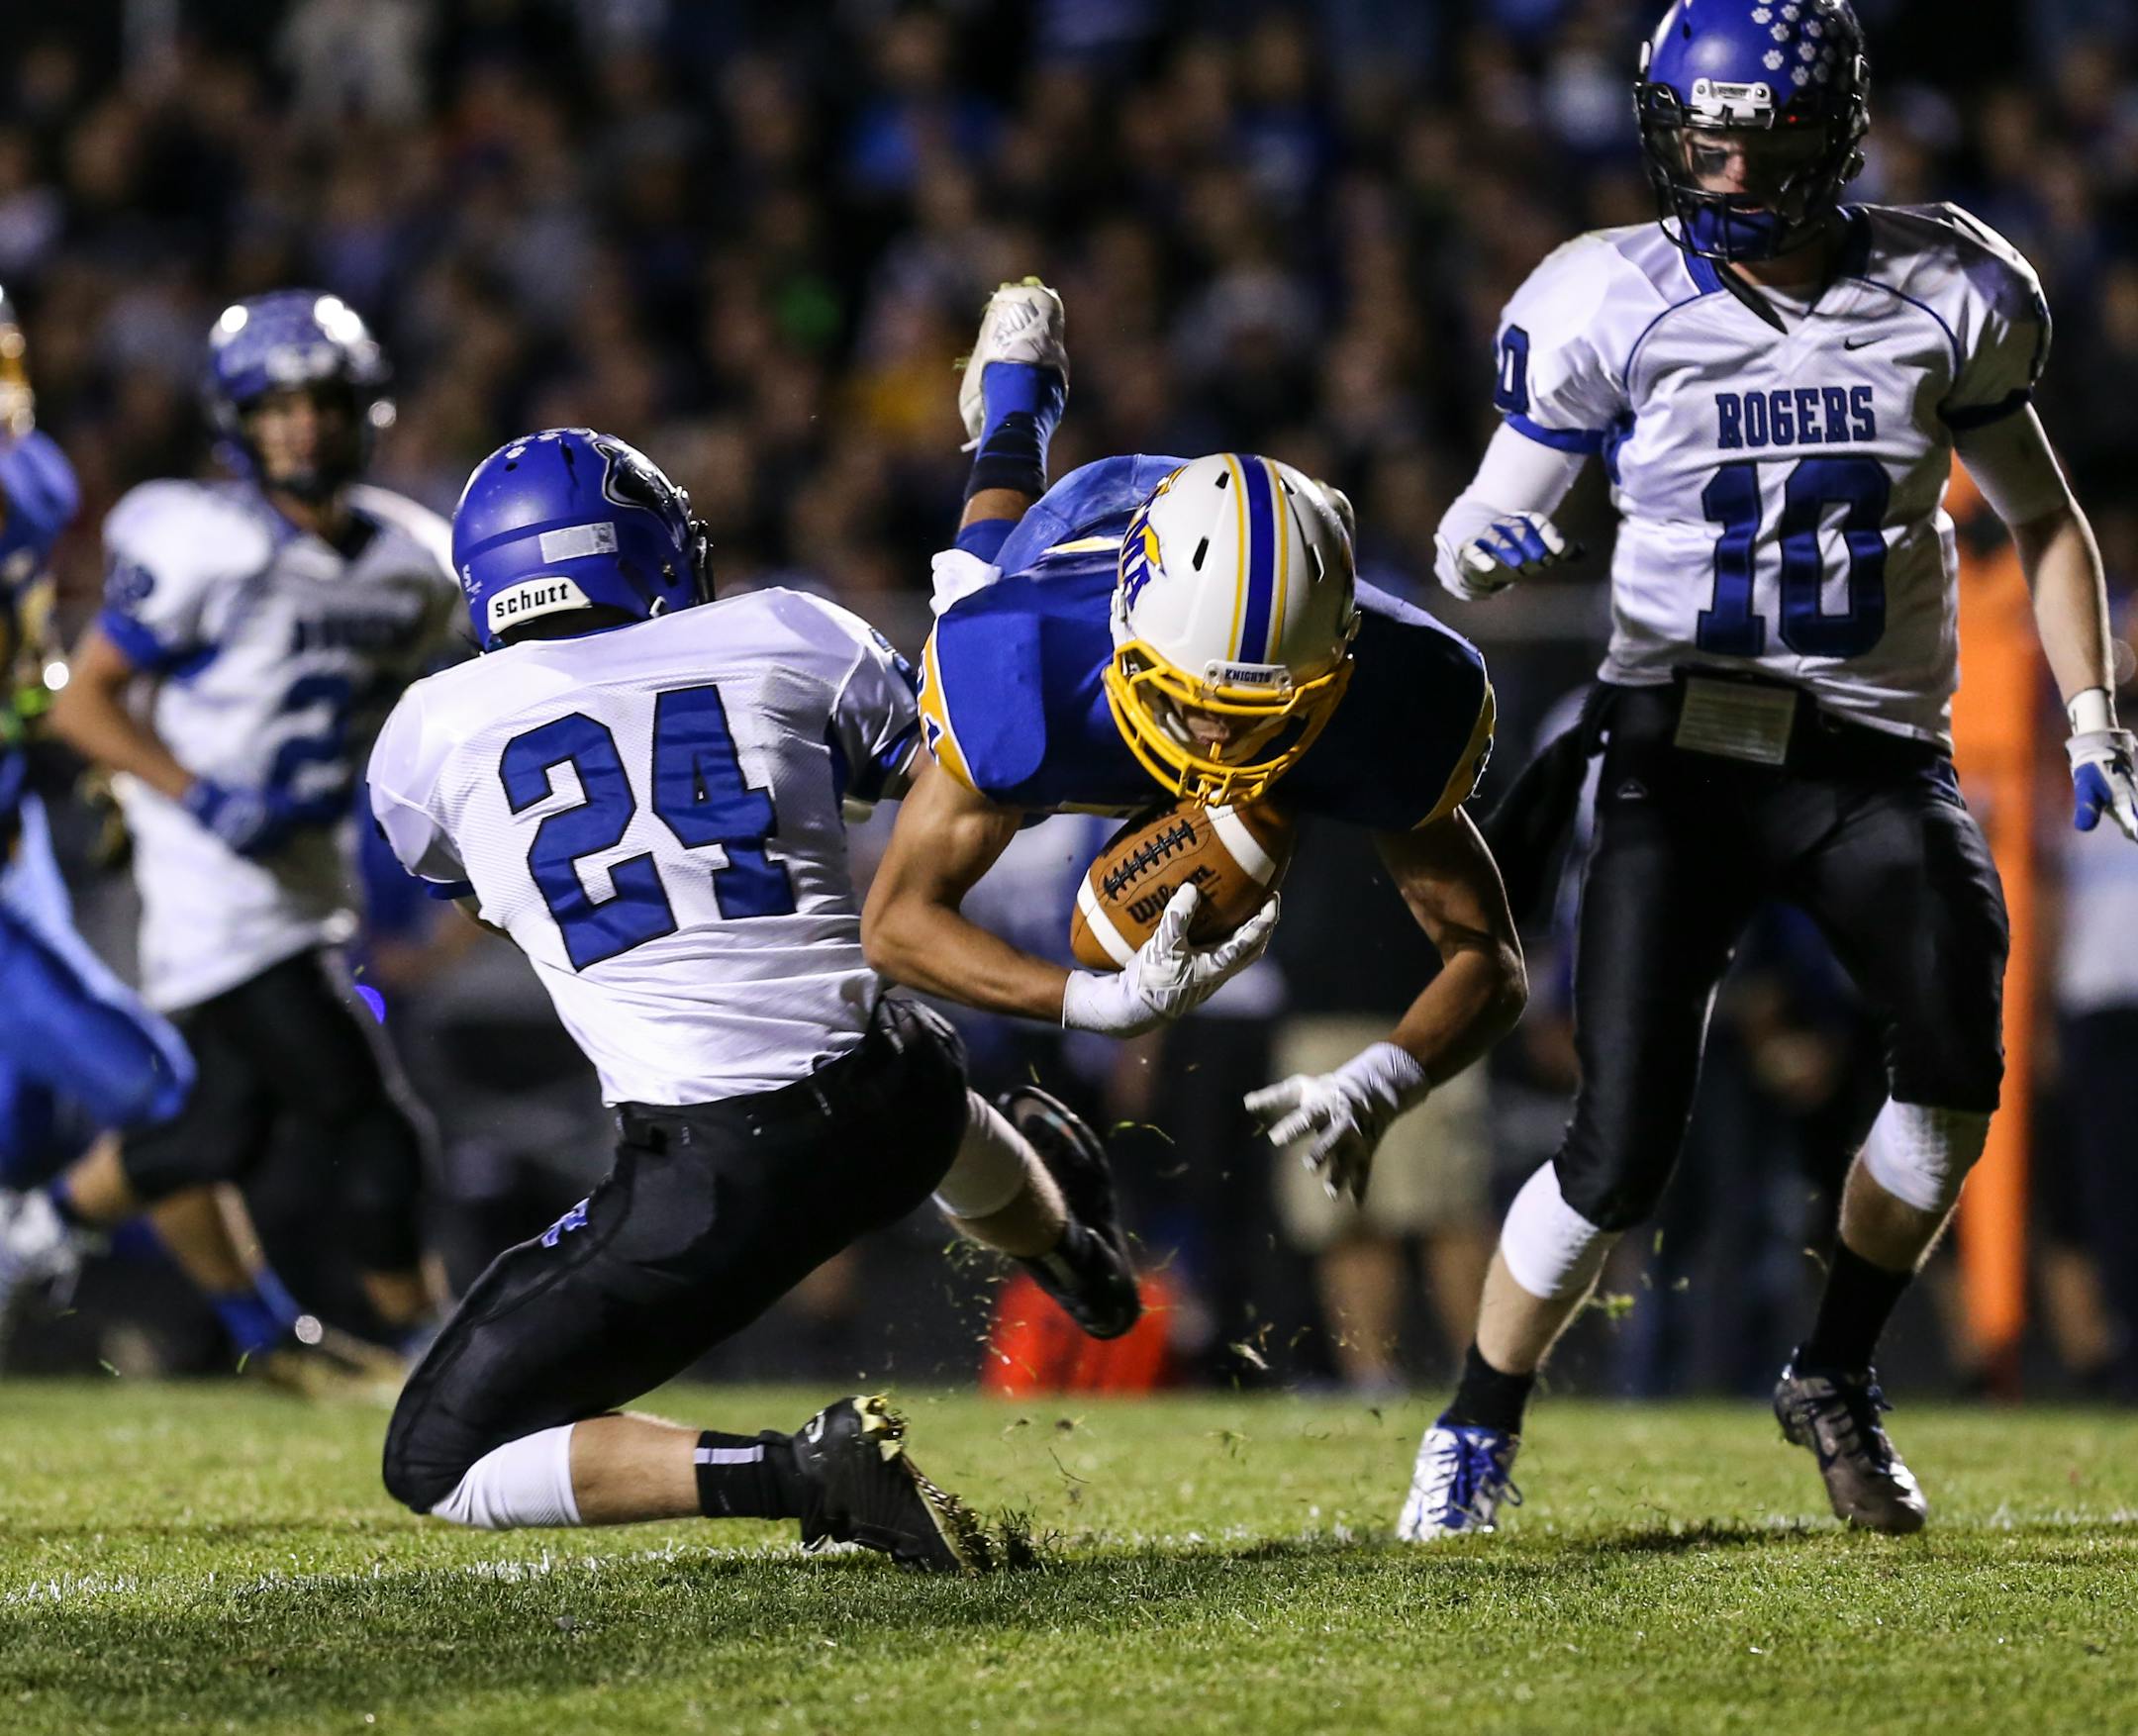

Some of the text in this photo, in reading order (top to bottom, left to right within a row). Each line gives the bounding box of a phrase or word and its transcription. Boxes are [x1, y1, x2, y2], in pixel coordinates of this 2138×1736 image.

[1715, 386, 1877, 448] ROGERS
[495, 582, 568, 618] schutt
[1696, 454, 1892, 658] 10
[499, 684, 796, 973] 24
